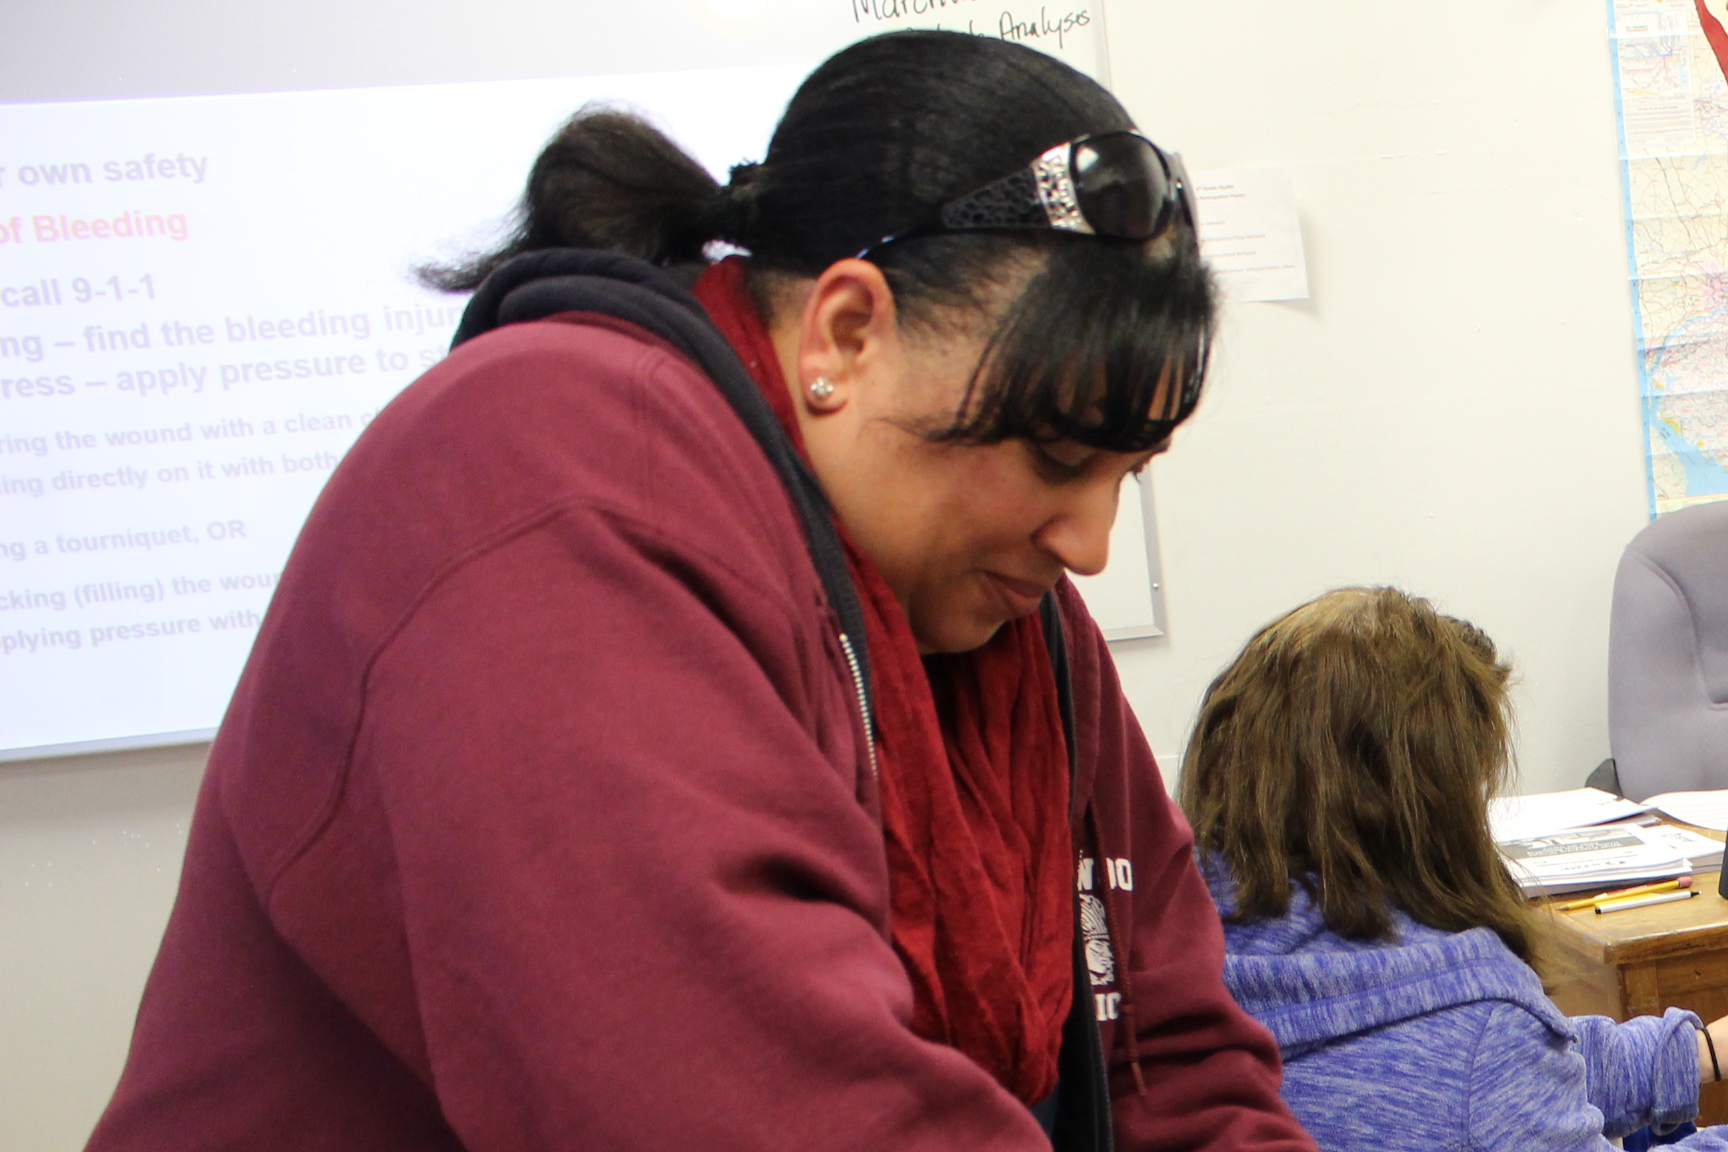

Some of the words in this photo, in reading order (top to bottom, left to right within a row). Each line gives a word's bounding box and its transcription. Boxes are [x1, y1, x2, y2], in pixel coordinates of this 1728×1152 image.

[17, 162, 93, 186] own
[102, 152, 209, 184] safety
[31, 210, 189, 242] Bleeding
[1, 278, 63, 308] call
[71, 272, 156, 303] 9-1-1
[83, 322, 152, 352] find
[160, 319, 215, 346] the
[225, 311, 370, 341] bleeding
[116, 361, 208, 397] apply
[219, 354, 368, 390] pressure
[376, 347, 409, 373] to
[55, 430, 96, 451] the
[104, 421, 194, 448] wound
[199, 418, 255, 440] with
[262, 424, 277, 436] a
[284, 412, 353, 434] clean
[51, 464, 148, 492] directly
[157, 464, 190, 483] on
[197, 459, 217, 481] it
[219, 455, 276, 479] with
[34, 538, 49, 556] a
[56, 523, 200, 553] tourniquet,
[206, 519, 249, 541] OR
[73, 577, 165, 609] (filling)
[171, 576, 213, 597] the
[89, 616, 203, 649] pressure
